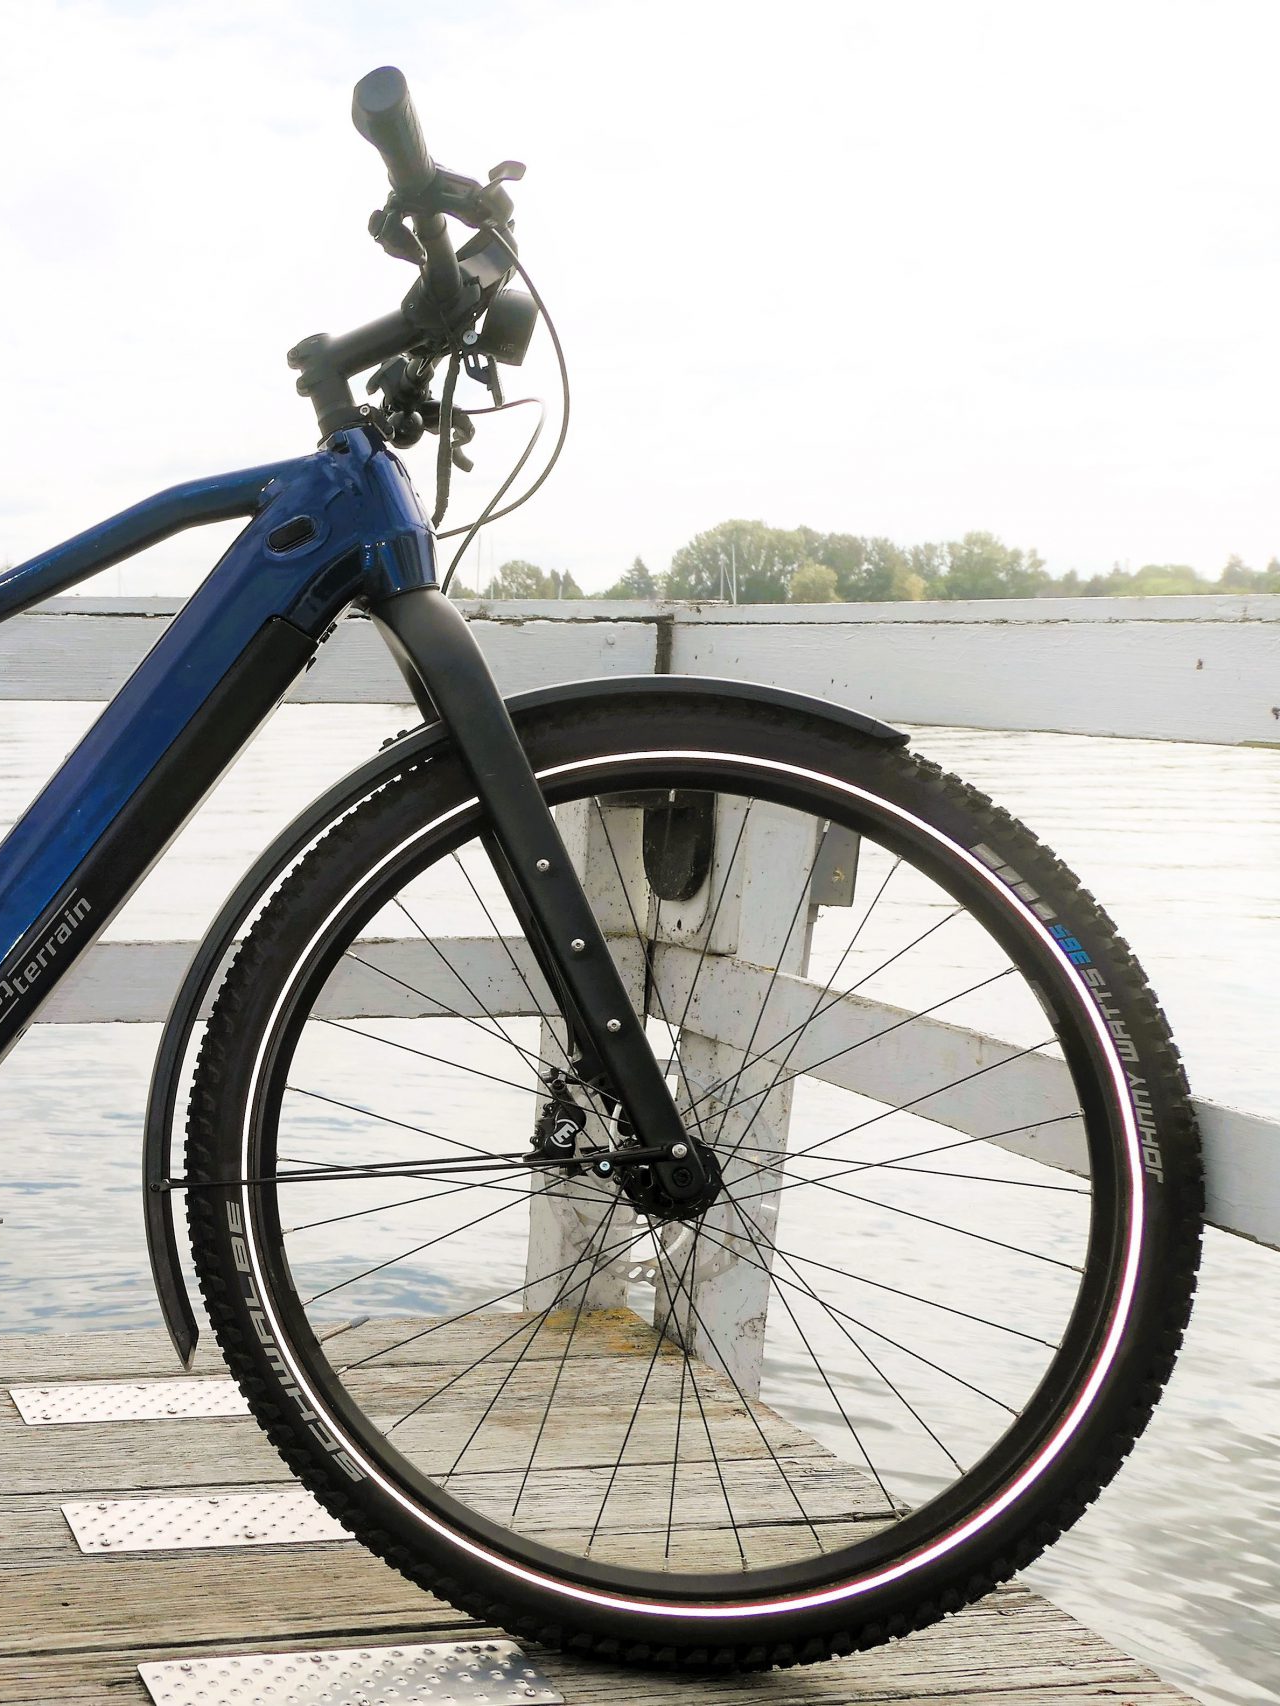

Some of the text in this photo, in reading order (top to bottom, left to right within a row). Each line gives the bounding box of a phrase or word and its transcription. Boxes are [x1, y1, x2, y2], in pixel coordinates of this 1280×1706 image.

[12, 897, 92, 995] terrain
[1048, 923, 1163, 1184] JOHNNY WATTS 365
[226, 1200, 367, 1483] SCHWALBE
